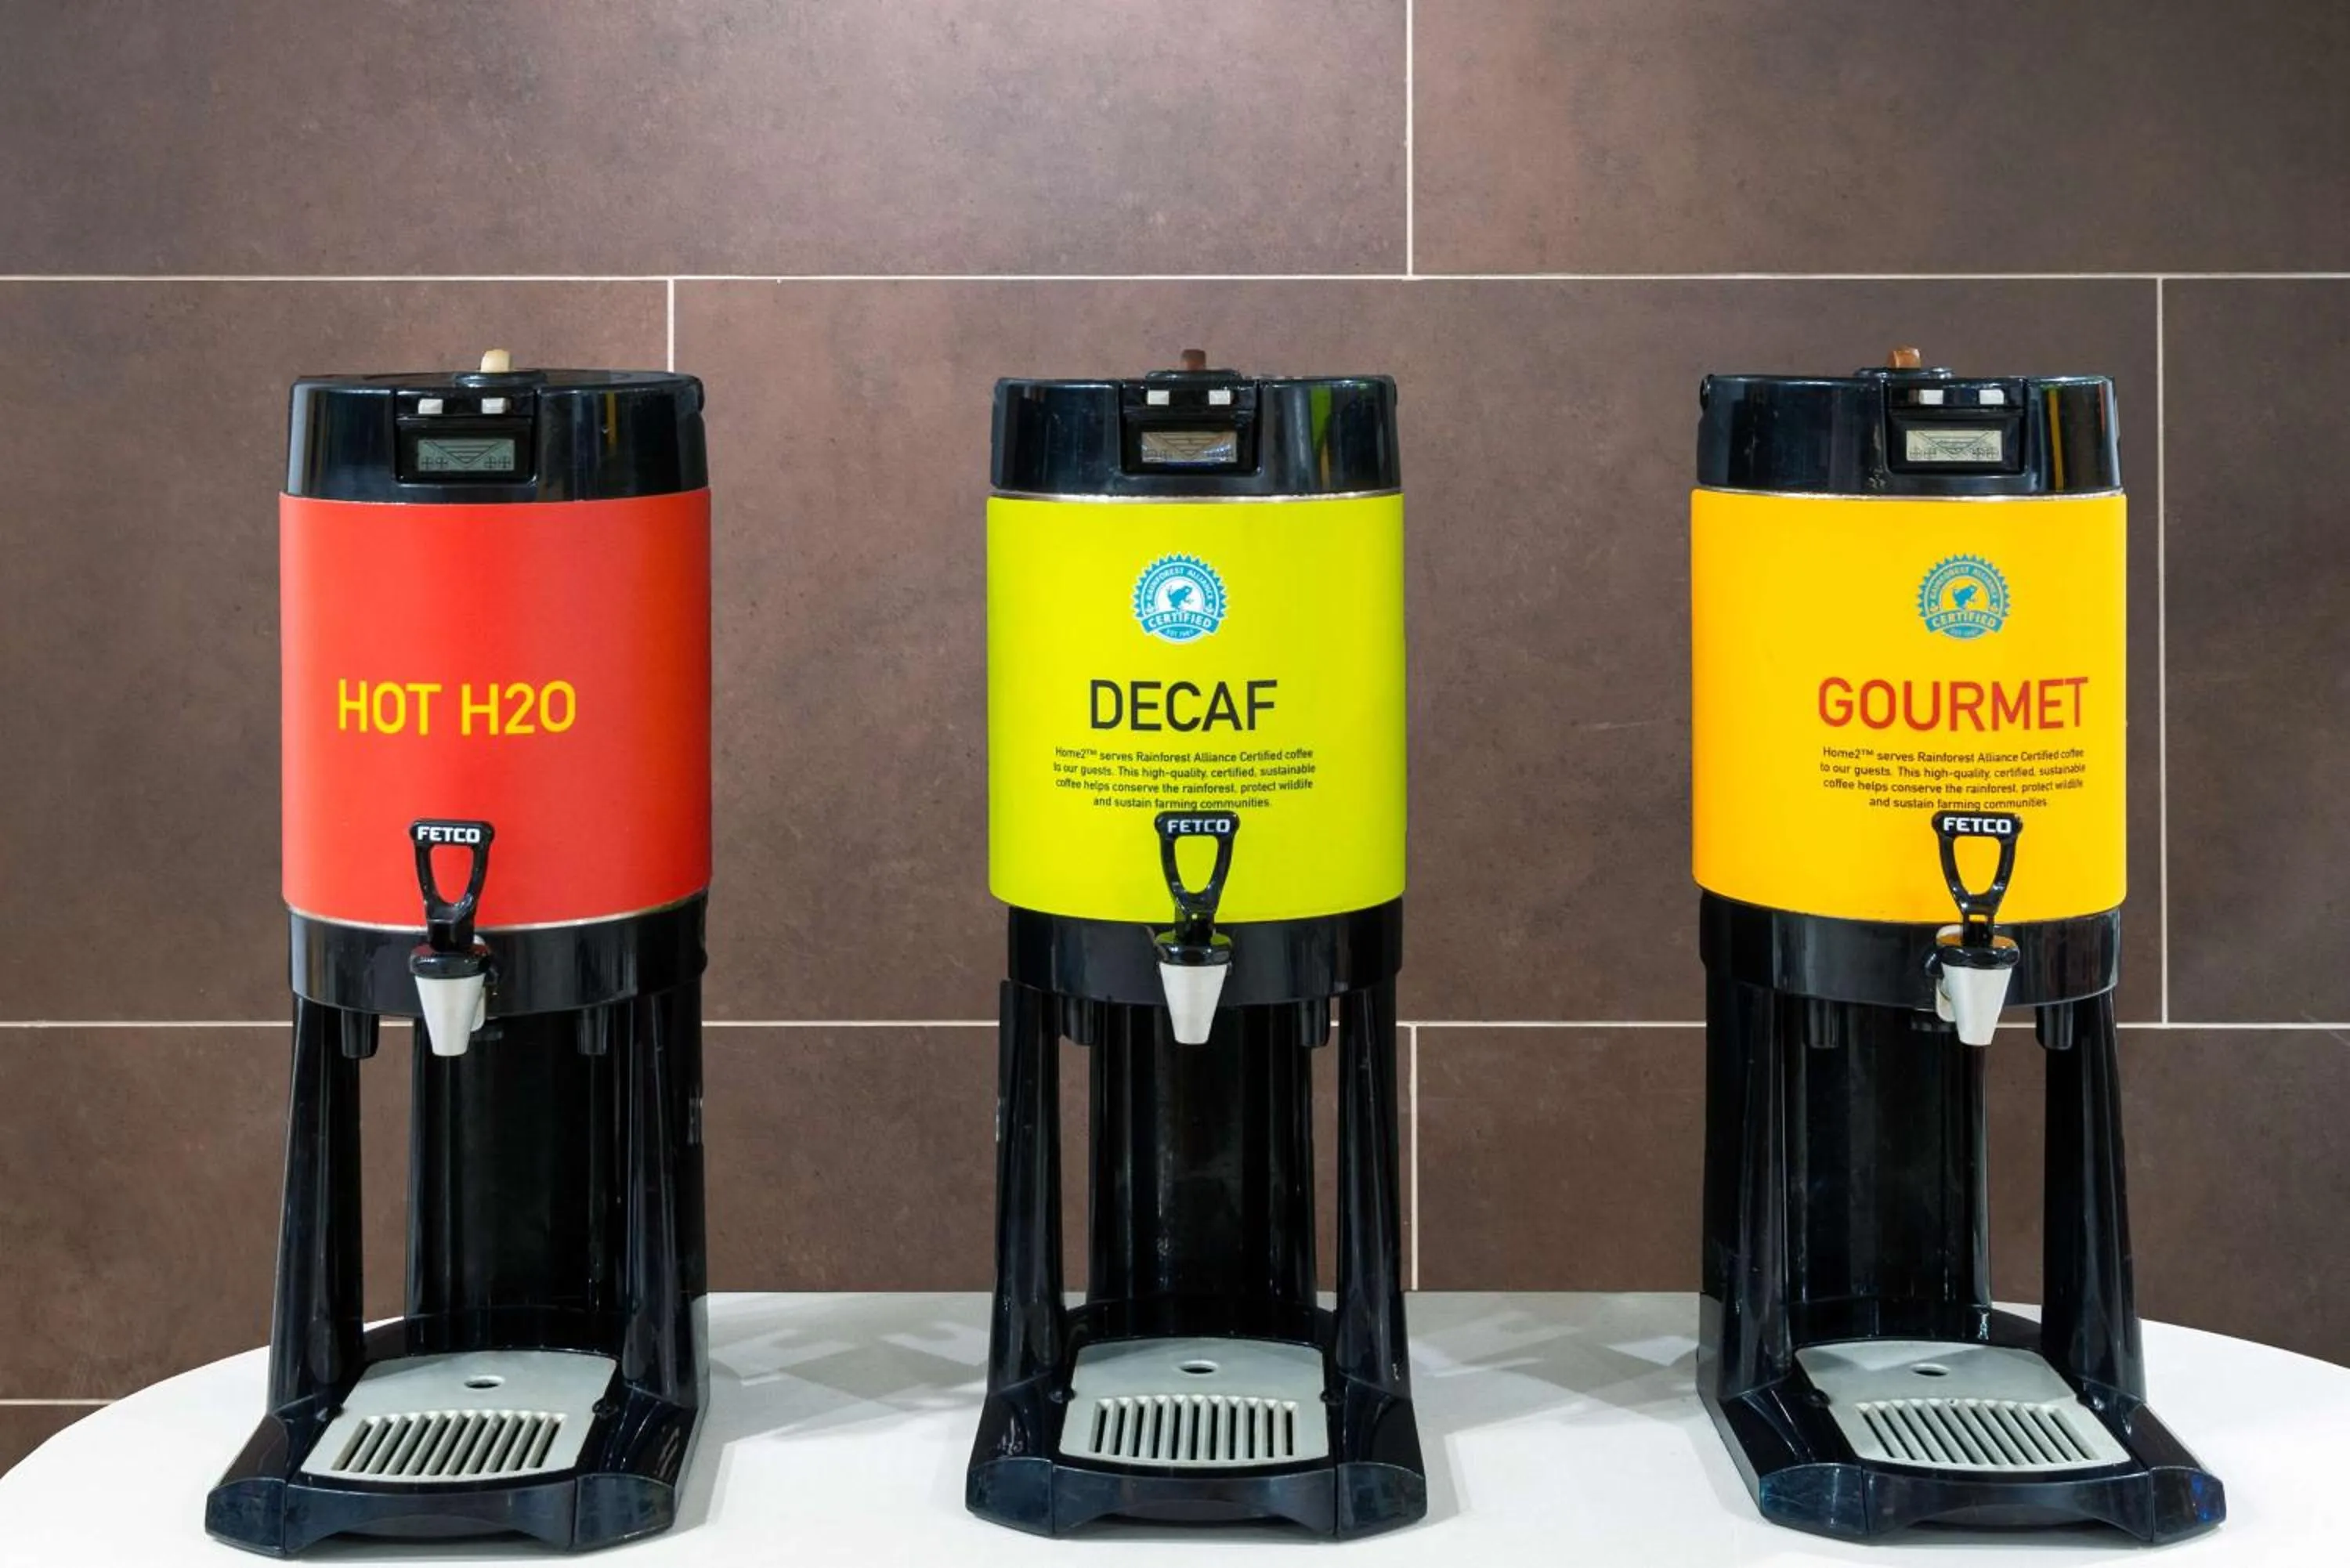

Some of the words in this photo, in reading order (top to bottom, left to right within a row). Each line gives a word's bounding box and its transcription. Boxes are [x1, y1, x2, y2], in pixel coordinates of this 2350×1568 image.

[1148, 611, 1213, 628] CERTIFIED
[1931, 611, 1997, 628] CERTIFIED
[338, 677, 443, 736] HOT
[1090, 679, 1278, 732] DECAF
[1818, 676, 2089, 732] GOURMET
[1099, 752, 1133, 761] serves
[1136, 751, 1191, 762] Rainforest
[1193, 751, 1237, 762] Alliance
[1239, 750, 1283, 762] Certified
[1284, 747, 1314, 760] coffee
[1876, 752, 1914, 762] serves
[1918, 751, 1975, 763] Rainforest
[1977, 752, 2019, 763] Alliance
[2020, 750, 2059, 762] Certified
[2060, 747, 2084, 760] coffee
[1063, 764, 1079, 773] our
[1118, 765, 1141, 777] This
[1260, 763, 1316, 776] sustainable
[1820, 762, 1831, 772] to
[1832, 764, 1850, 774] our
[1898, 765, 1920, 778] This
[2039, 763, 2086, 776] sustainable
[1055, 778, 1083, 789] coffee
[1083, 780, 1110, 793] helps
[1112, 783, 1160, 793] conserve
[1162, 782, 1179, 793] the
[1240, 781, 1277, 794] protect
[1278, 779, 1314, 791] wildlife
[1823, 778, 1855, 789] coffee
[1857, 780, 1889, 793] helps
[1890, 783, 1942, 793] conserve
[1944, 782, 1962, 793] the
[2021, 782, 2053, 795] protect
[2055, 779, 2084, 791] wildlife
[1093, 797, 1112, 807] and
[1113, 797, 1153, 808] sustain
[1154, 798, 1198, 811] farming
[1868, 797, 1890, 807] and
[1893, 797, 1934, 809] sustain
[1937, 799, 1981, 811] farming
[1167, 818, 1231, 833] FETCO
[1943, 817, 2012, 834] FETCO
[418, 826, 480, 843] FETCO
